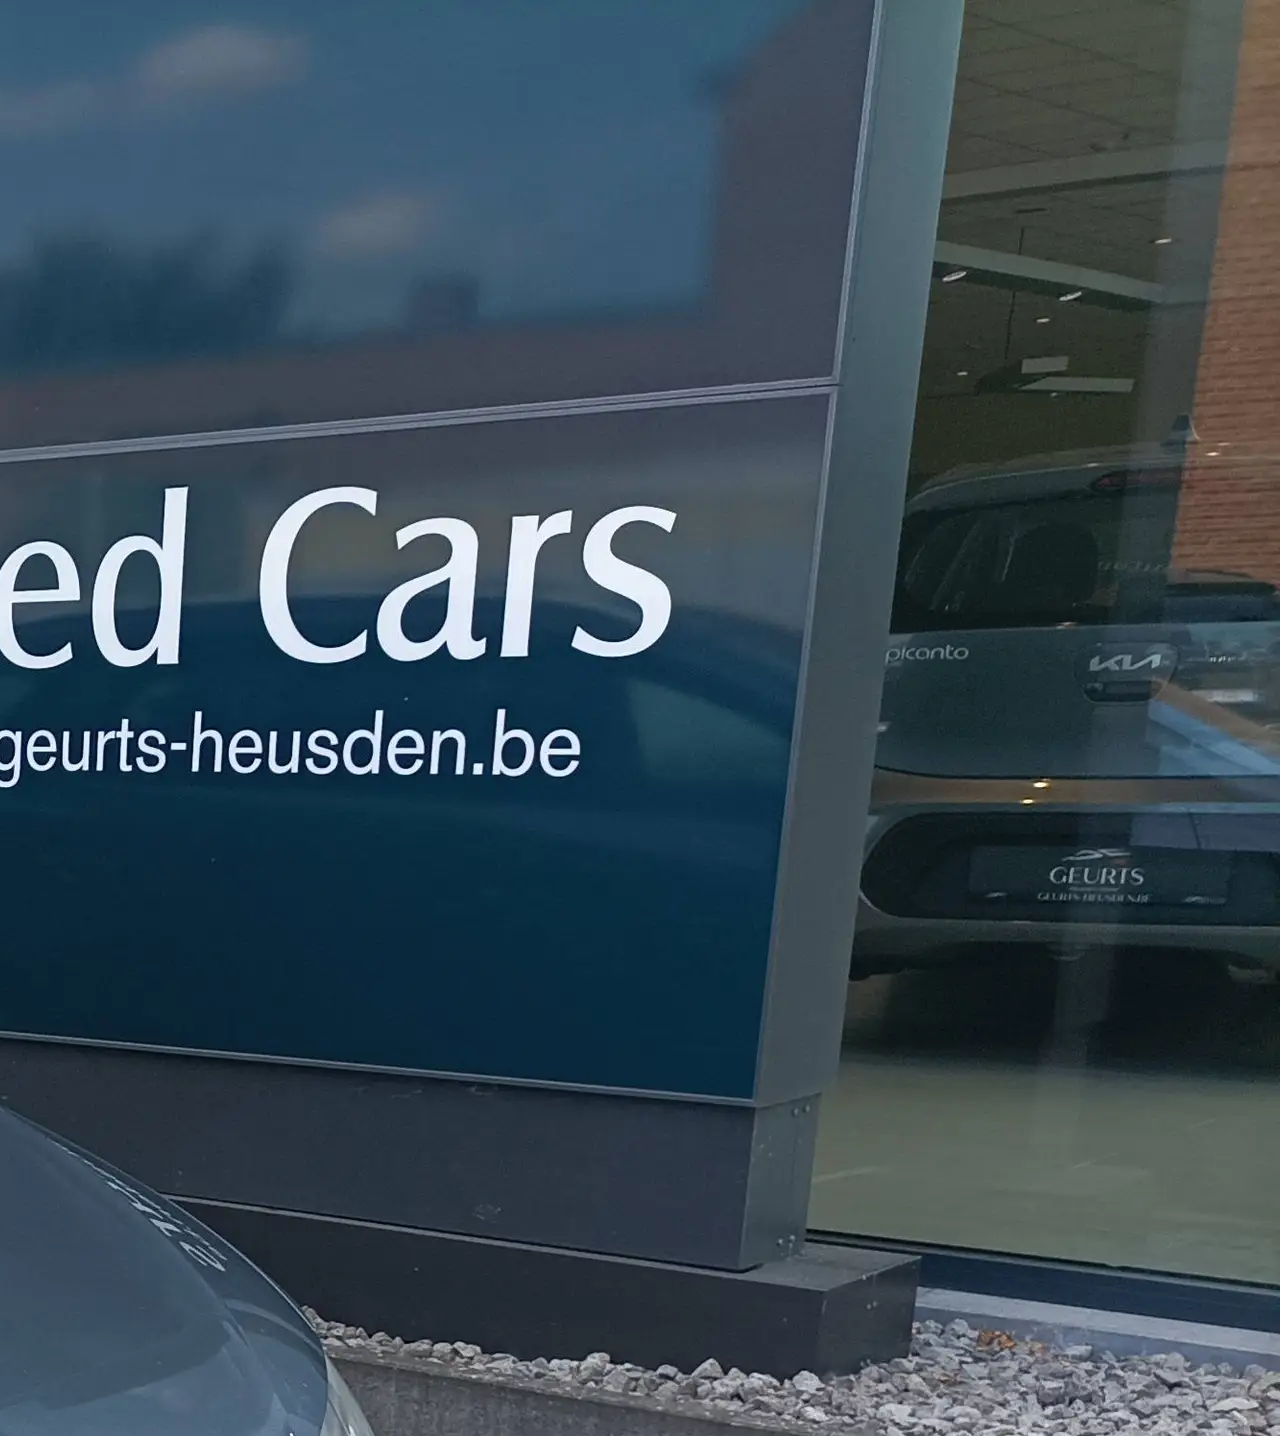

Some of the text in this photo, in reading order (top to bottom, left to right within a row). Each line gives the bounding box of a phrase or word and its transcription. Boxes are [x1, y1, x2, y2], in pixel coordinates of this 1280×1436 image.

[258, 485, 678, 665] Cars
[885, 644, 969, 667] picanto
[1049, 866, 1145, 886] GEURTS
